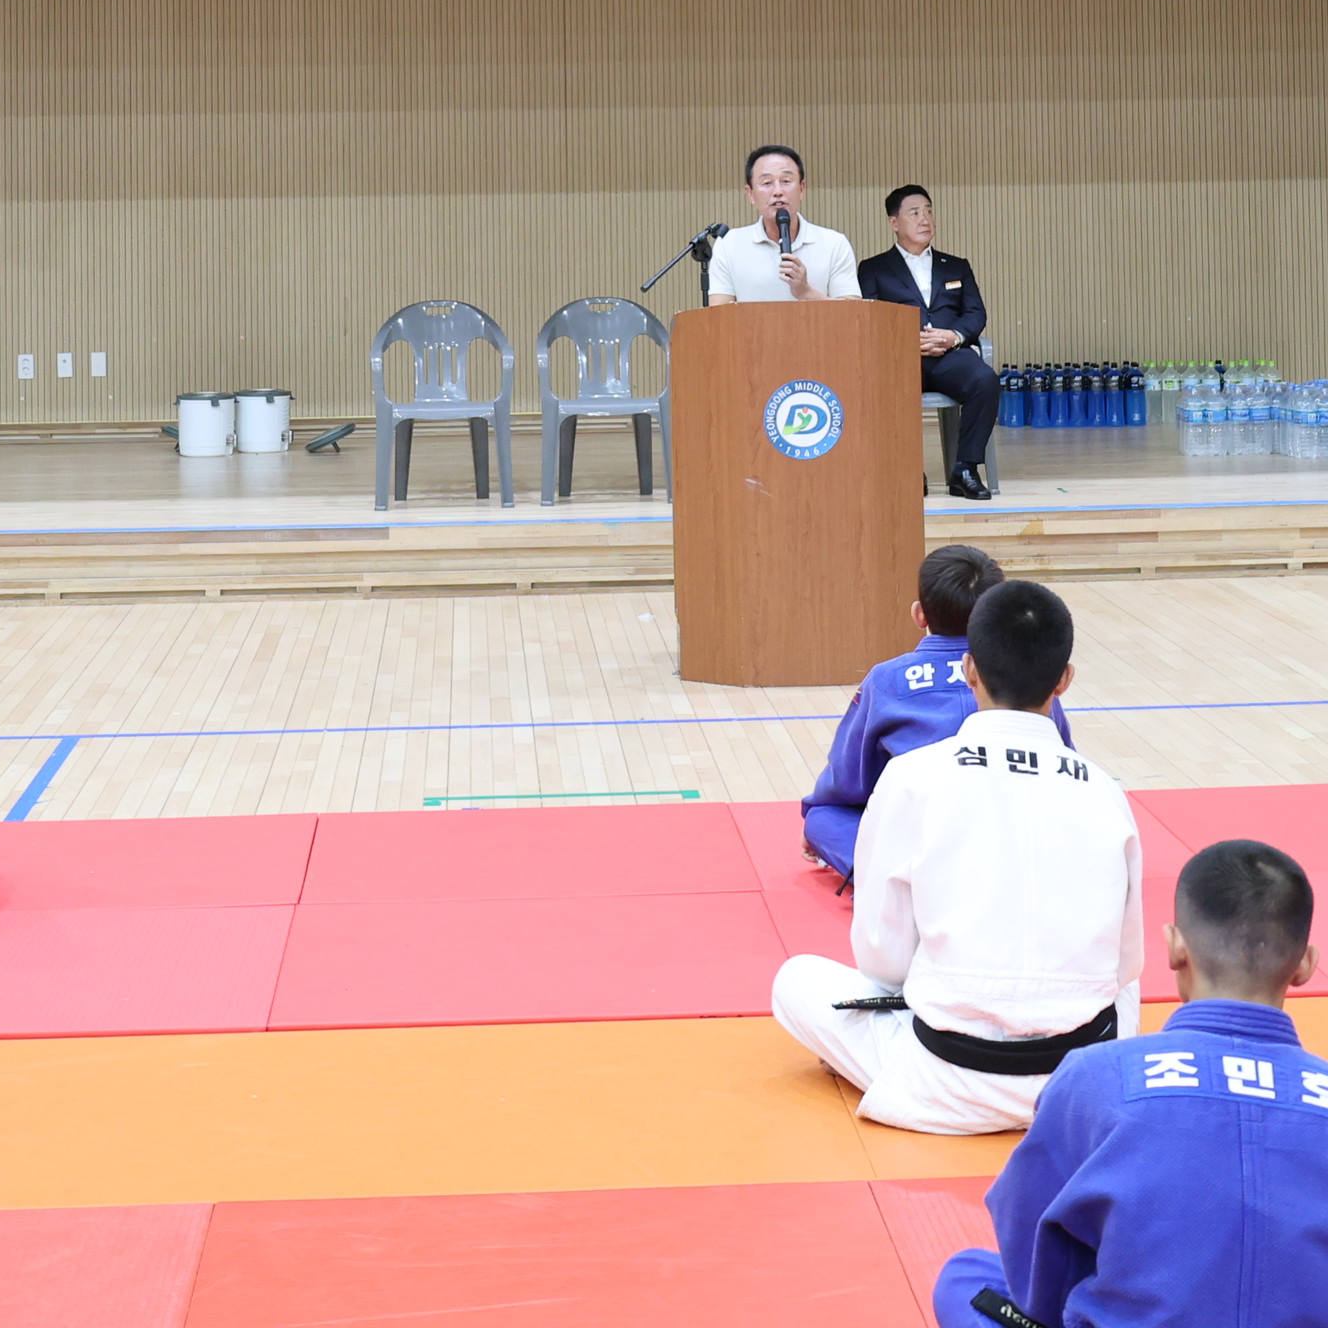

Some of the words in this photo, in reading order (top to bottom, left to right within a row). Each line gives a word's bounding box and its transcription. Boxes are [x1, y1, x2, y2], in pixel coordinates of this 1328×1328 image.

[766, 386, 792, 443] YEONGDONG
[794, 382, 831, 400] MIDDLE
[828, 400, 841, 439] SCHOOL
[785, 446, 820, 458] 1946
[953, 745, 1089, 782] 심민재
